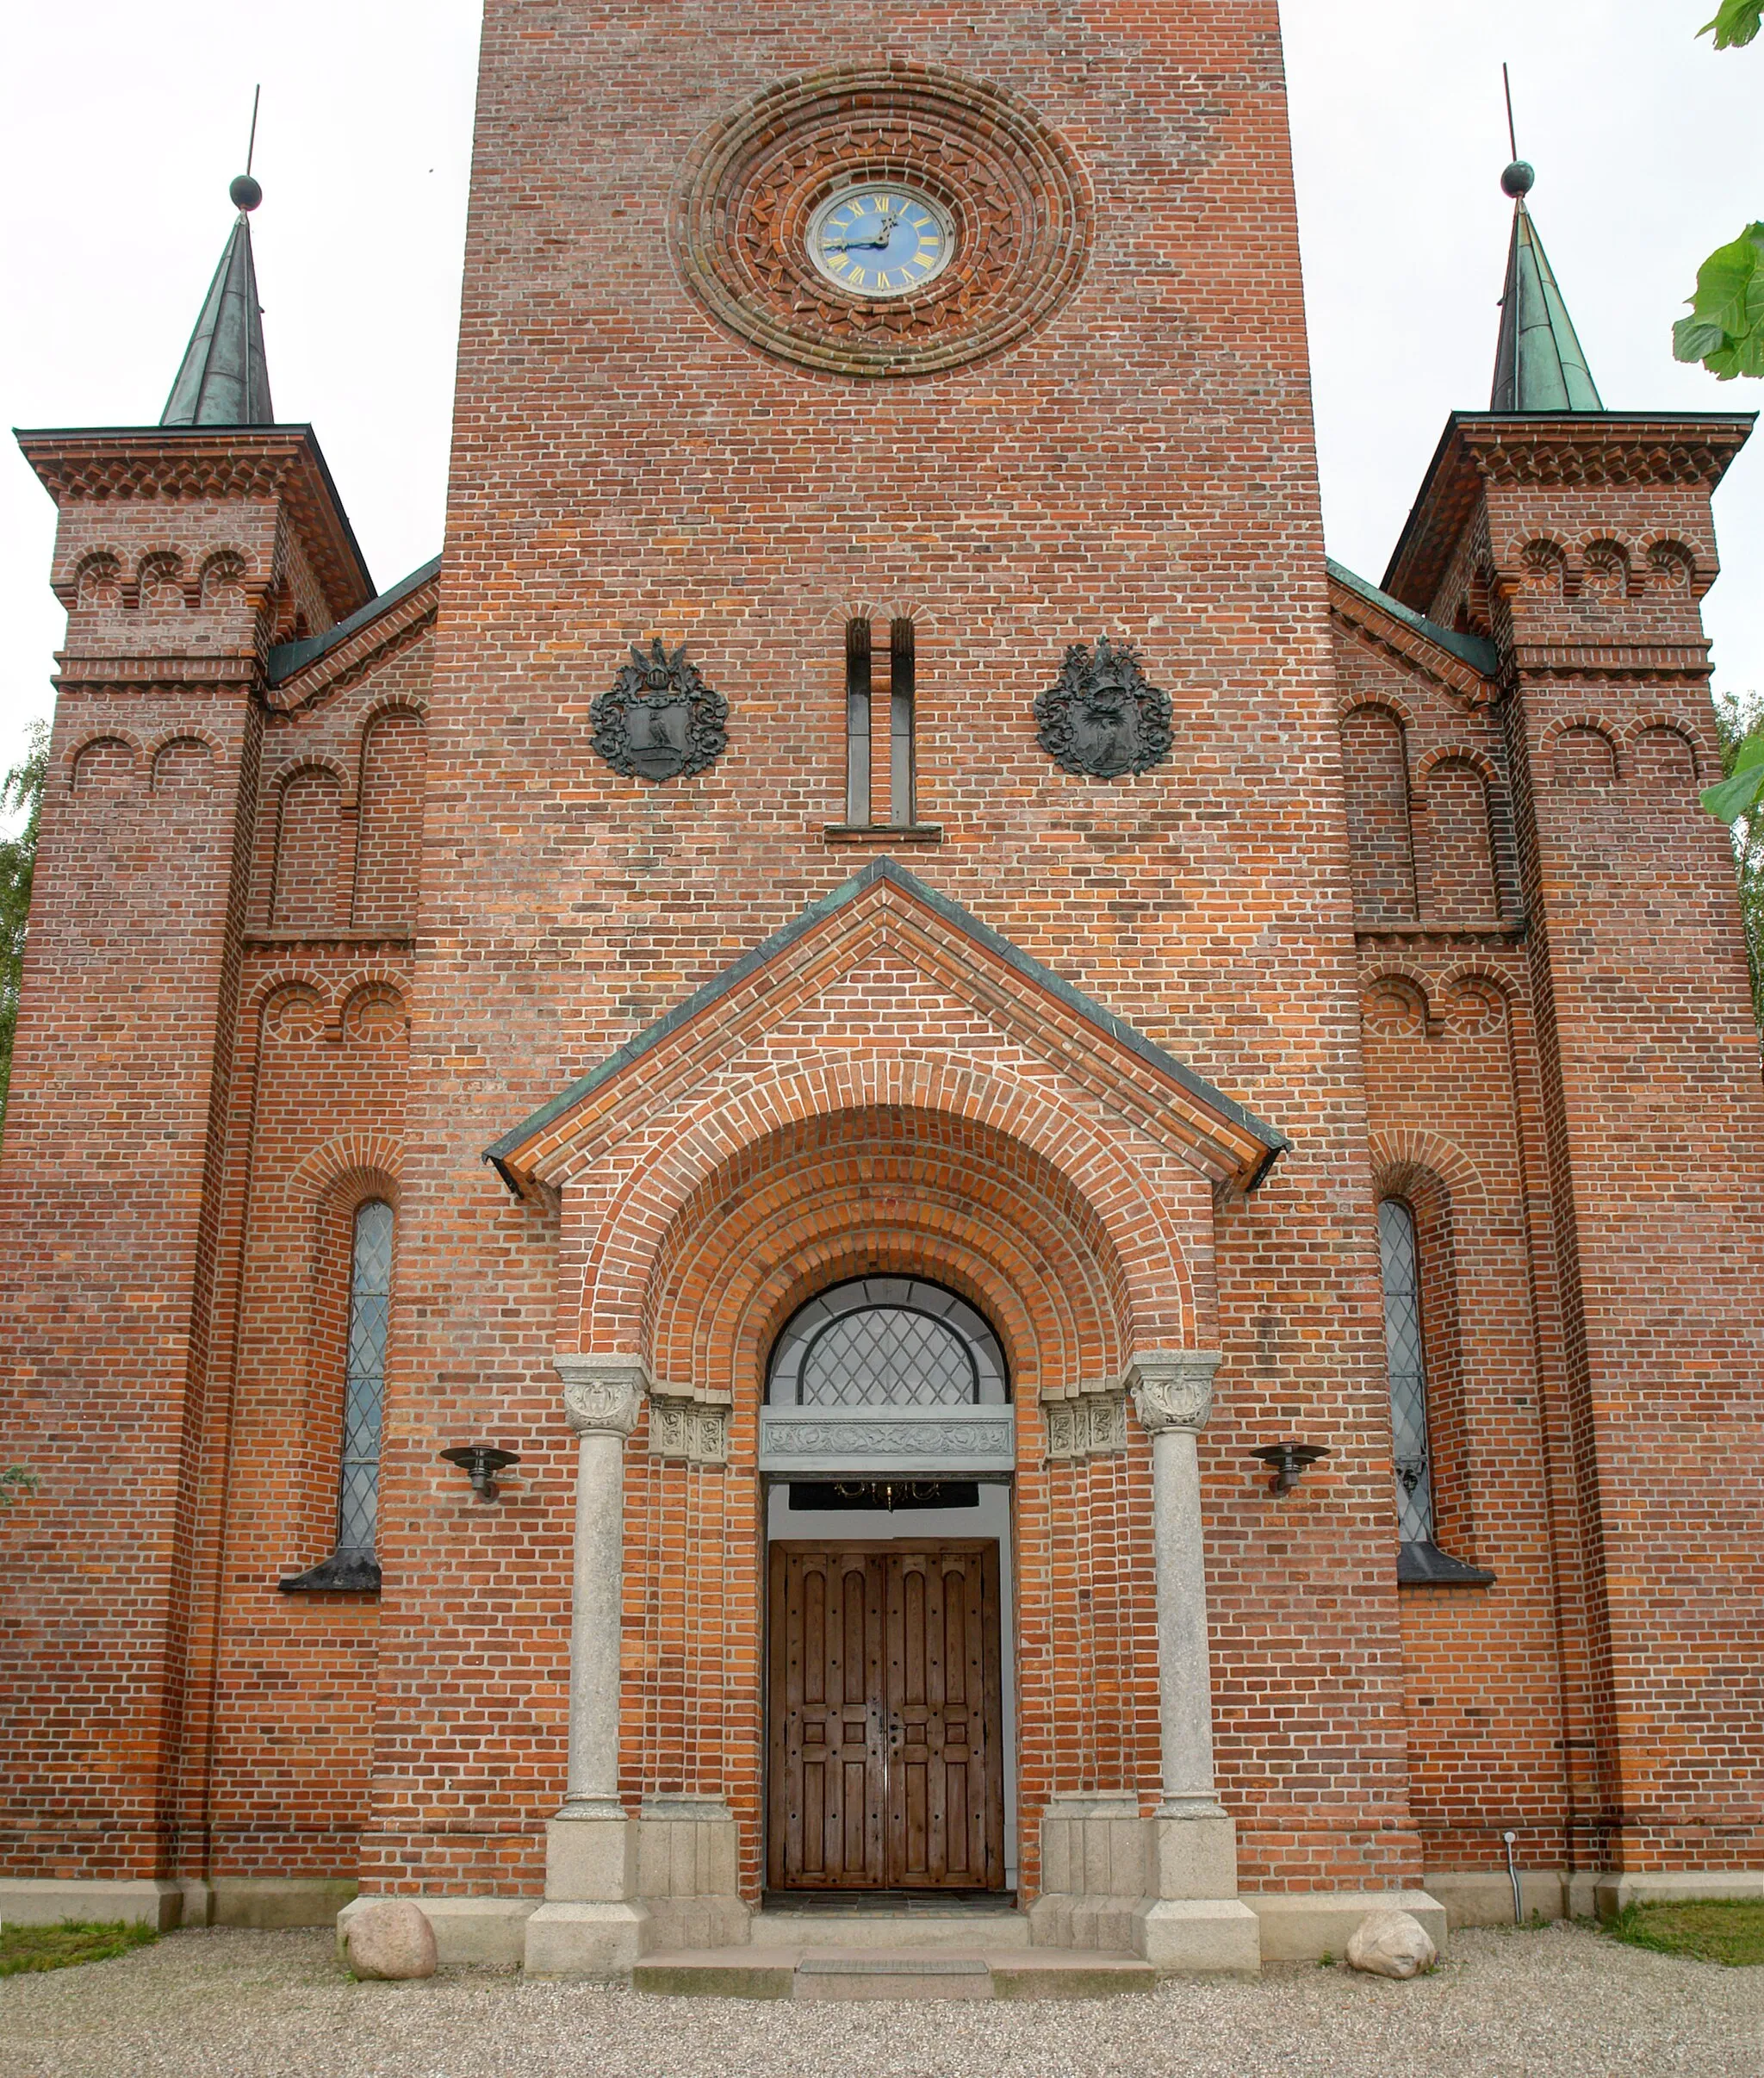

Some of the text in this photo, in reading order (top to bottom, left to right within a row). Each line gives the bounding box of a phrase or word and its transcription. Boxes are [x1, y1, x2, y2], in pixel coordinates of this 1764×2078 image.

[847, 199, 865, 218] XI
[874, 196, 889, 213] XII
[898, 199, 911, 215] I
[913, 216, 933, 228] II
[920, 237, 938, 246] III
[827, 252, 850, 272] VIII
[913, 252, 936, 270] IIII
[848, 265, 866, 285] VII
[878, 271, 891, 289] VI
[900, 267, 915, 283] V
